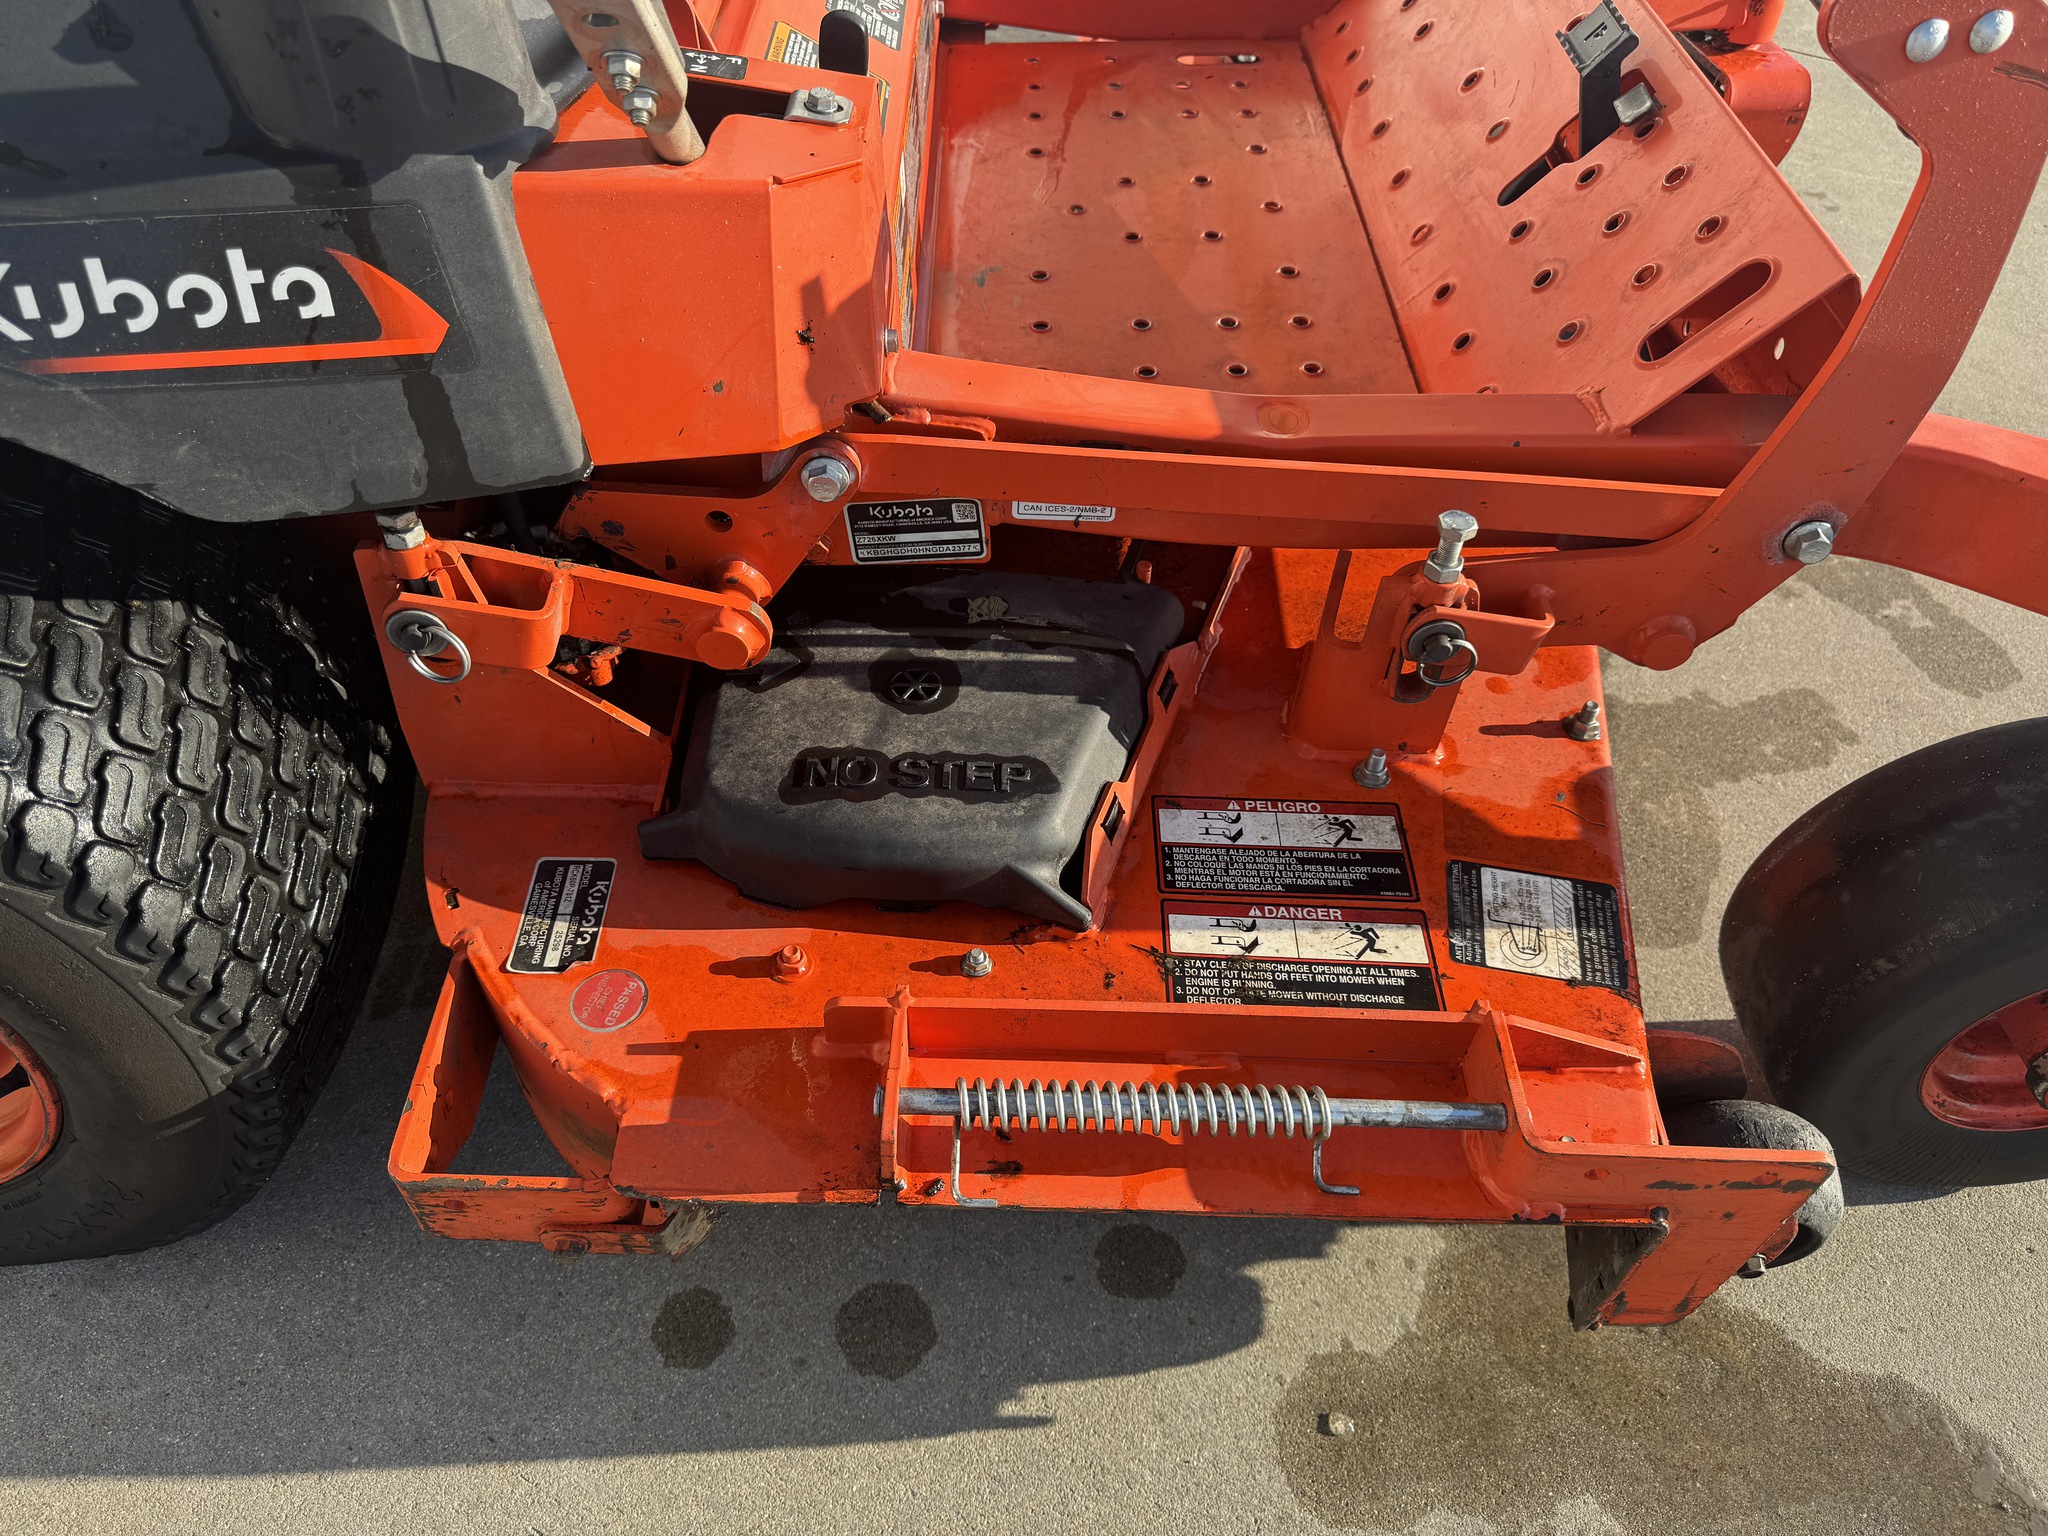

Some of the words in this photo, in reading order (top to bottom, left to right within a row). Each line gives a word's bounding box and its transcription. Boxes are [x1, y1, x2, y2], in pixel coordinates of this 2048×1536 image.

[690, 64, 707, 72] N
[726, 56, 742, 65] F
[869, 504, 933, 518] Kubota
[1045, 505, 1106, 514] ICES-2/NMB-2
[803, 756, 879, 788] NO
[897, 758, 1031, 792] STEP
[1244, 800, 1321, 813] PELIGRO
[550, 866, 565, 897] KUBOTA
[579, 864, 593, 889] MODEL
[1176, 881, 1223, 890] DEFLECTOR
[1238, 884, 1285, 892] DESCARGA.
[1295, 872, 1369, 880] FUNCIONAMIENTO.
[1453, 892, 1461, 918] ROLLER
[1577, 884, 1585, 909] contact
[1587, 890, 1592, 898] as
[522, 883, 542, 933] GAINESVILLE,
[534, 889, 550, 923] AMERICA
[576, 881, 609, 945] Kubota
[1264, 906, 1343, 920] DANGER
[1604, 899, 1614, 936] incorrectly.
[532, 899, 556, 964] MANUFACTURING
[566, 916, 579, 943] SERIAL
[1587, 900, 1597, 943] continuously
[518, 935, 528, 947] GA
[526, 924, 540, 949] CORP.
[552, 930, 563, 952] 25298
[562, 944, 571, 958] NO.
[1473, 942, 1481, 963] height
[1592, 944, 1602, 970] ground
[1184, 960, 1208, 968] STAY
[1242, 961, 1255, 970] OF
[1257, 962, 1310, 973] DISCHARGE
[1312, 965, 1353, 974] OPENING
[1355, 967, 1367, 975] AT
[1370, 968, 1387, 976] ALL
[1388, 968, 1419, 978] TIMES.
[1601, 947, 1612, 985] premature
[1612, 958, 1620, 986] develop
[1185, 978, 1220, 987] ENGINE
[1221, 970, 1238, 978] PUT
[1241, 971, 1273, 980] HANDS
[1290, 973, 1313, 982] FEET
[1316, 975, 1337, 983] INTO
[1340, 975, 1375, 984] MOWER
[1377, 977, 1405, 986] WHEN
[580, 975, 610, 1019] INSPECTOR
[595, 987, 613, 1010] CHIEF
[605, 981, 637, 1026] PASSED
[1186, 986, 1199, 994] DO
[1268, 990, 1304, 1000] MOWER
[1306, 992, 1348, 1002] WITHOUT
[1350, 993, 1405, 1004] DISCHARGE
[1187, 995, 1244, 1005] DEFLECTOR.
